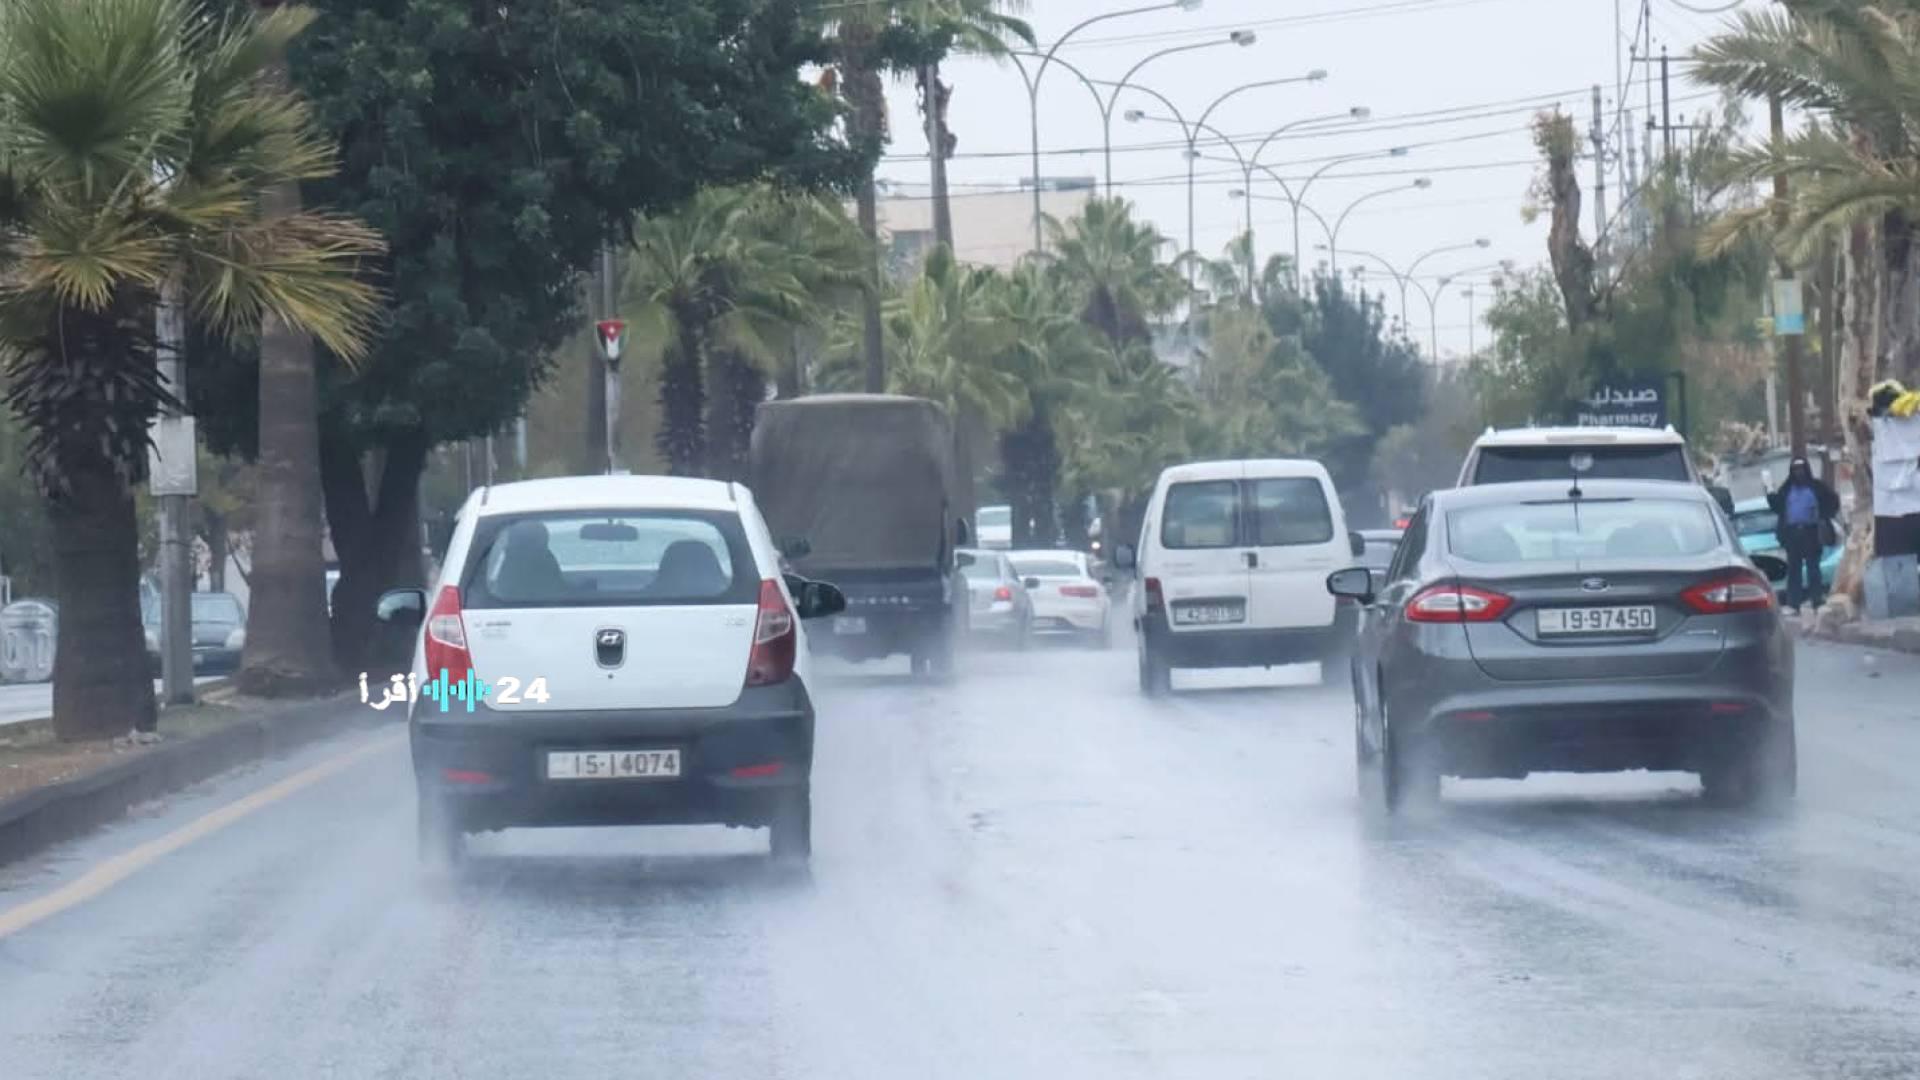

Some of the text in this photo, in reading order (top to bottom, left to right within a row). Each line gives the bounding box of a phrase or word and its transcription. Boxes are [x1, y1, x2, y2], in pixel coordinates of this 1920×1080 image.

[1585, 385, 1658, 408] صيدلي
[1578, 413, 1658, 427] Pharmacy
[1561, 608, 1652, 629] 19-97450
[574, 752, 676, 777] 15-14074
